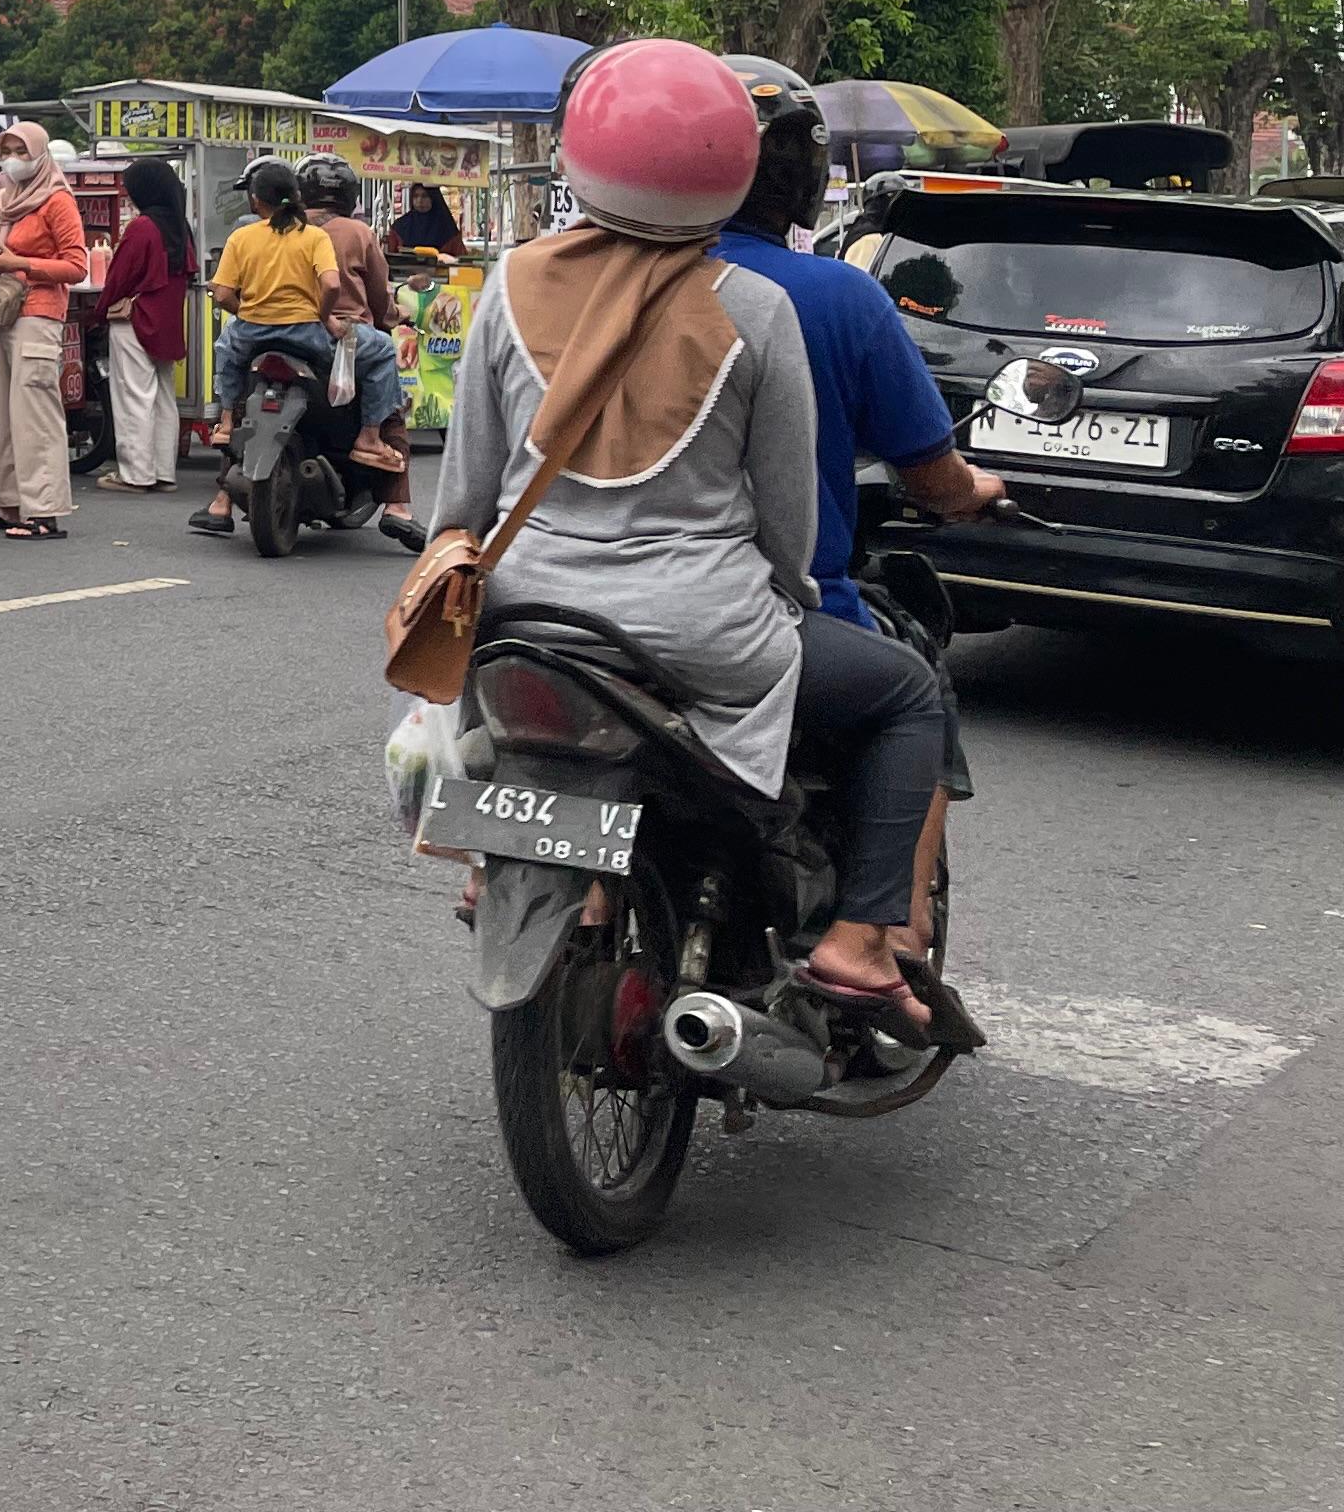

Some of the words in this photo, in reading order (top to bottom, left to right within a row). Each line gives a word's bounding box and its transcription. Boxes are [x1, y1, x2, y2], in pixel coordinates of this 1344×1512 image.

[427, 337, 461, 354] KEBAB
[1124, 418, 1160, 448] ZI
[429, 776, 447, 810] L
[475, 784, 558, 826] 4634
[600, 803, 642, 840] VJ
